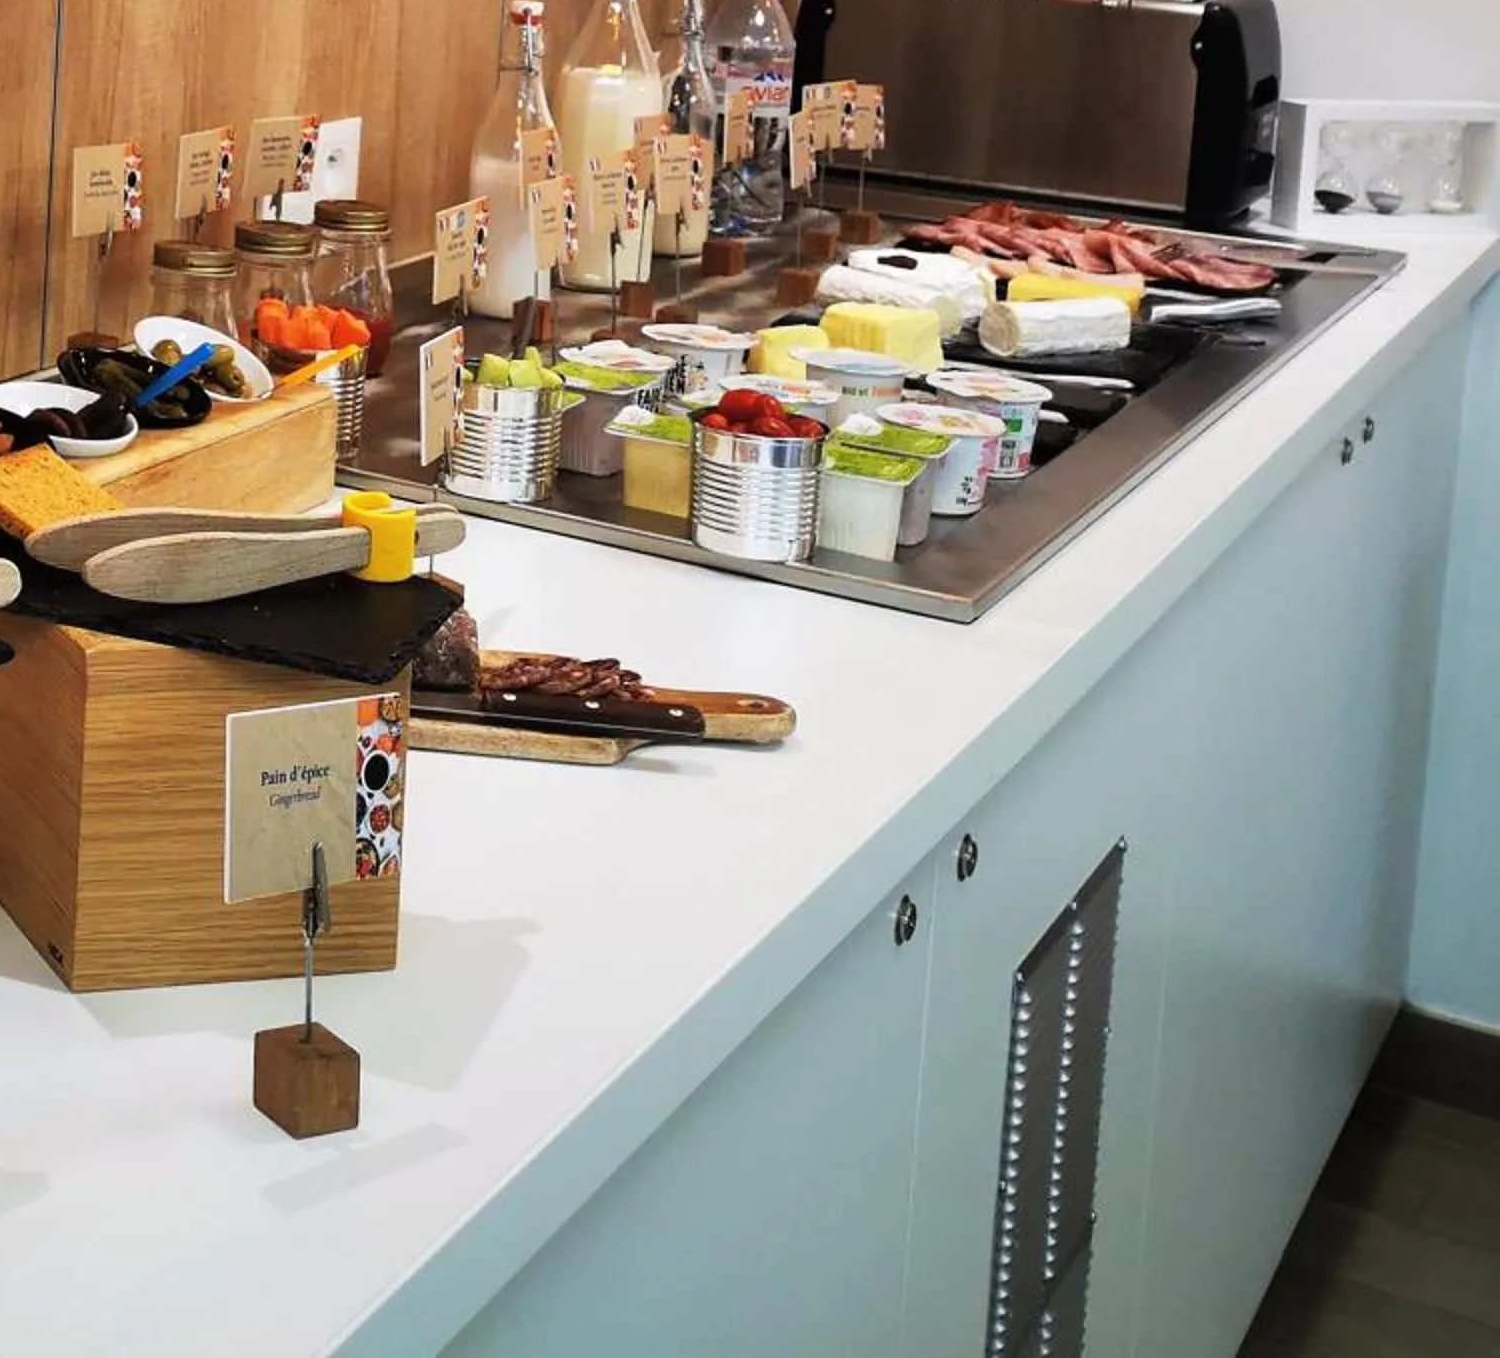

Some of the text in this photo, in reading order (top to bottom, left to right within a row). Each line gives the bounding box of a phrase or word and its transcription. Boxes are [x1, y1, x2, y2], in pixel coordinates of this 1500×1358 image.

[260, 763, 331, 787] Pain d'épice
[268, 787, 321, 809] Gingerbread
